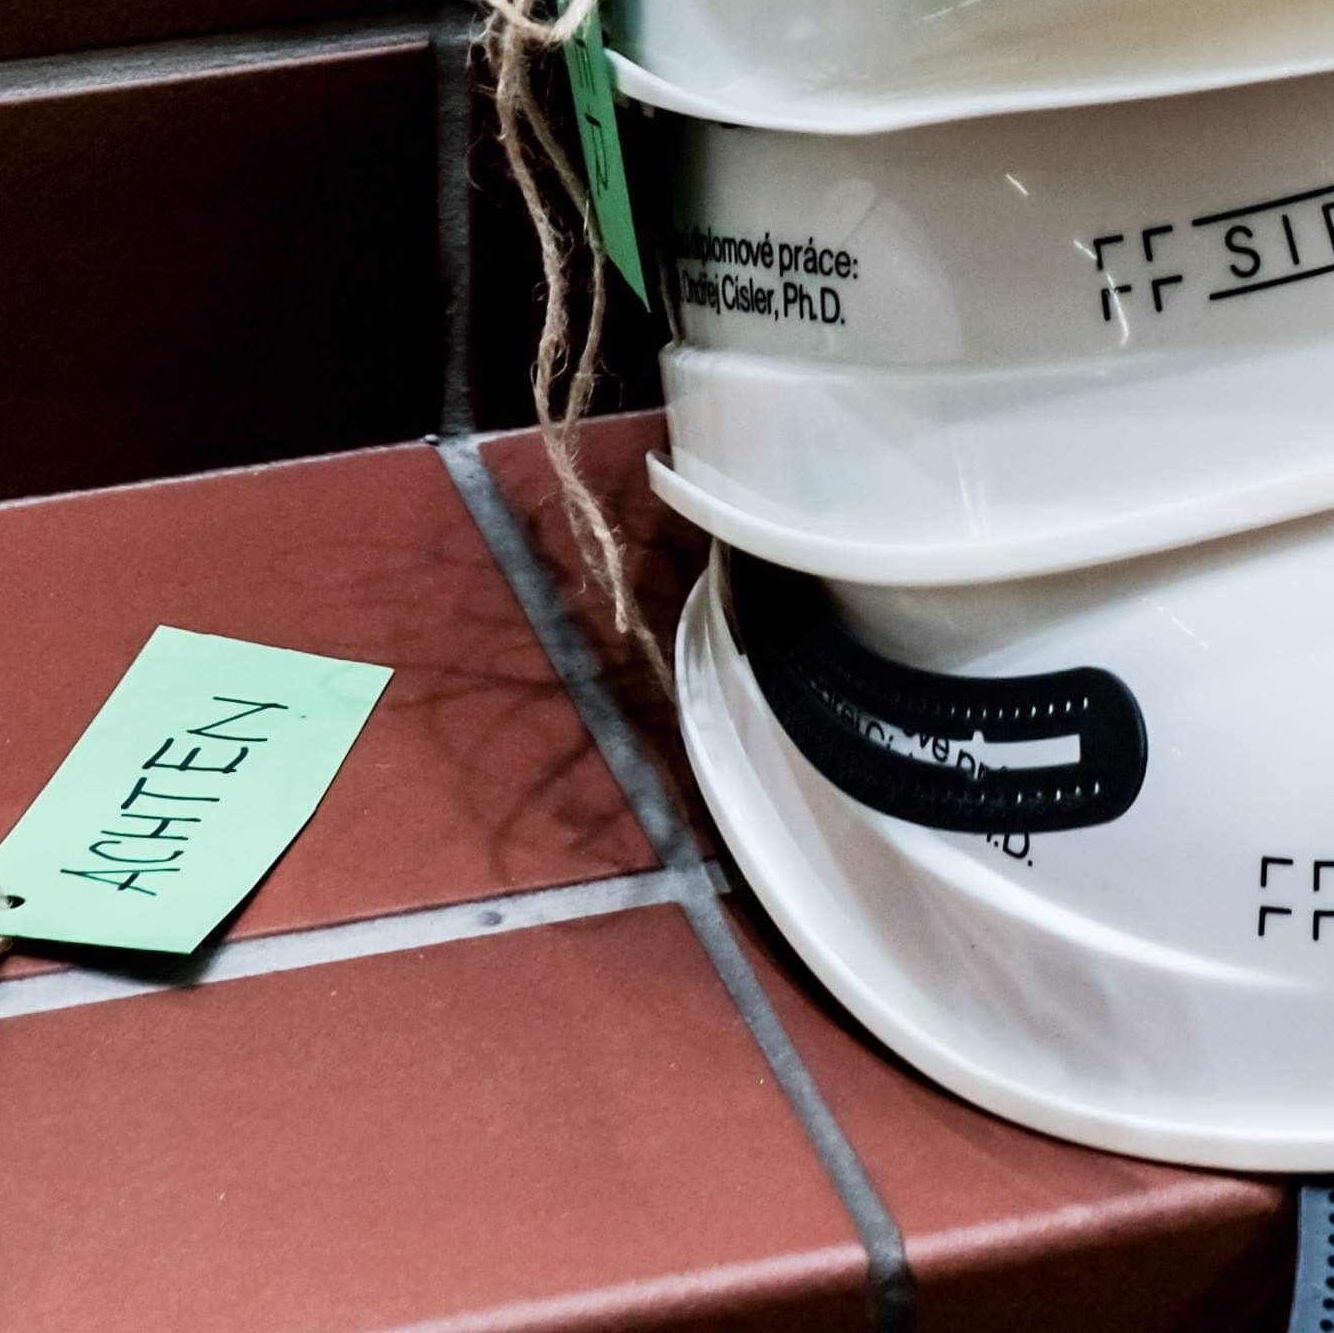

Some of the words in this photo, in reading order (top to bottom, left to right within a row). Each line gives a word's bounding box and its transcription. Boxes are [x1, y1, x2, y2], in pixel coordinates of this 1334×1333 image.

[778, 236, 859, 280] práce:
[782, 281, 846, 325] Ph.D.
[59, 695, 290, 897] ACHTEN
